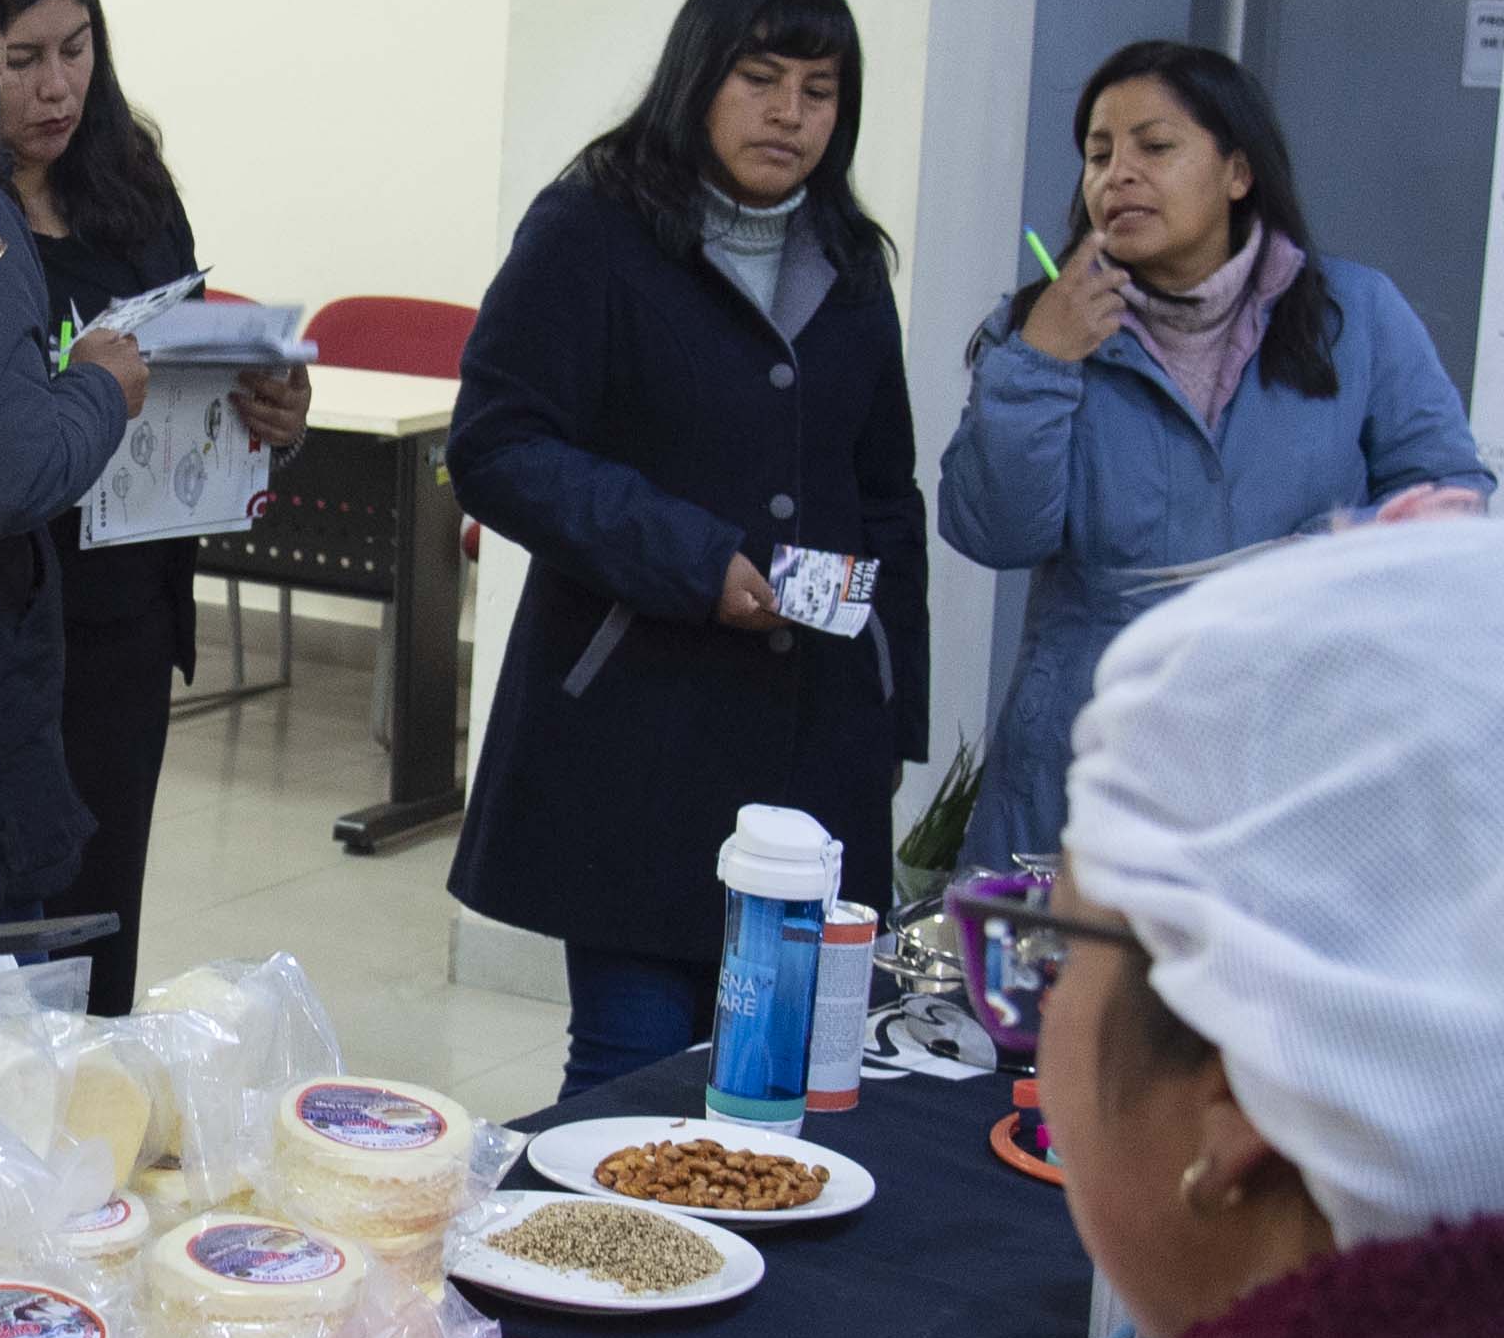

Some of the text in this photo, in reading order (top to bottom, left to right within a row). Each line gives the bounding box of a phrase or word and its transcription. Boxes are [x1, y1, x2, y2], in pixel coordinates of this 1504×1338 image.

[848, 561, 865, 601] WARE
[859, 562, 877, 601] RENA
[721, 969, 757, 996] ENA
